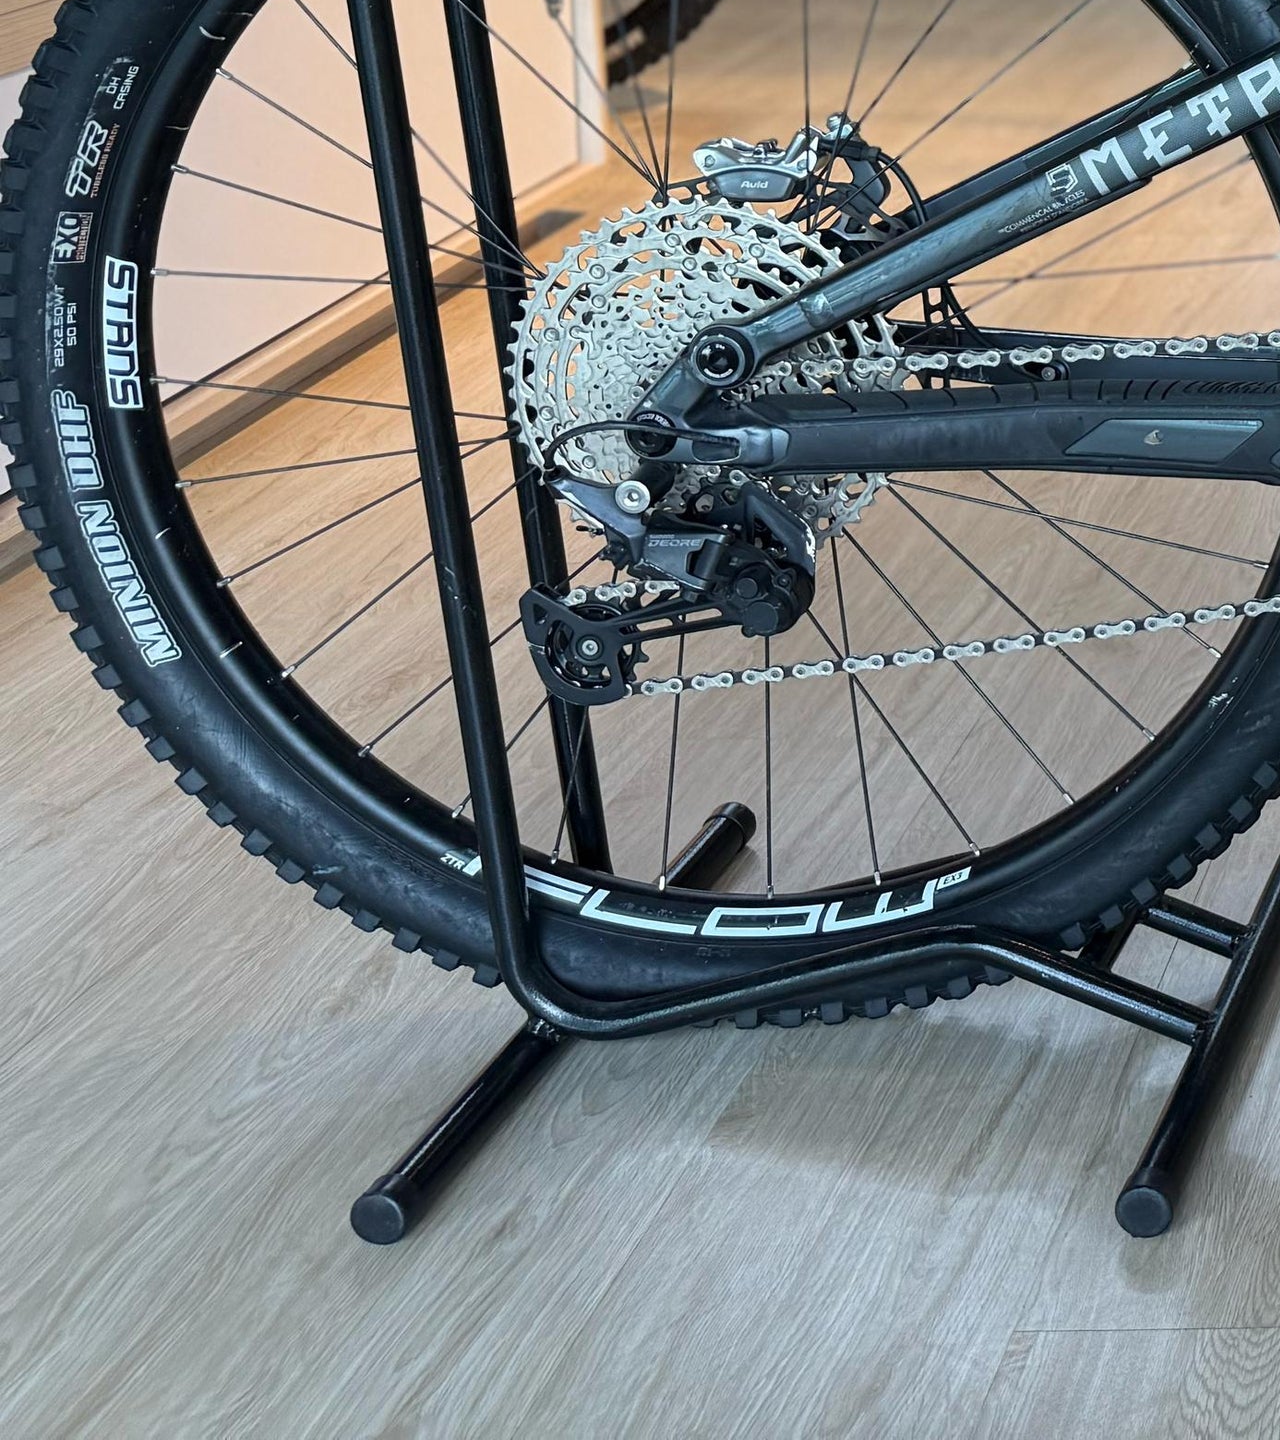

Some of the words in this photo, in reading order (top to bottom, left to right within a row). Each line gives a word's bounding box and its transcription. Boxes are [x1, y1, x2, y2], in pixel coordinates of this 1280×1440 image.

[106, 76, 122, 95] DH
[113, 65, 140, 110] CASING
[104, 122, 121, 152] READY
[56, 212, 81, 259] EXO
[53, 285, 65, 368] 29X2.50WT
[66, 302, 78, 324] PSI
[66, 327, 78, 347] 50
[51, 389, 104, 491] DHF
[648, 538, 701, 548] DEORE
[76, 500, 182, 667] MINION
[439, 853, 467, 871] ZTR
